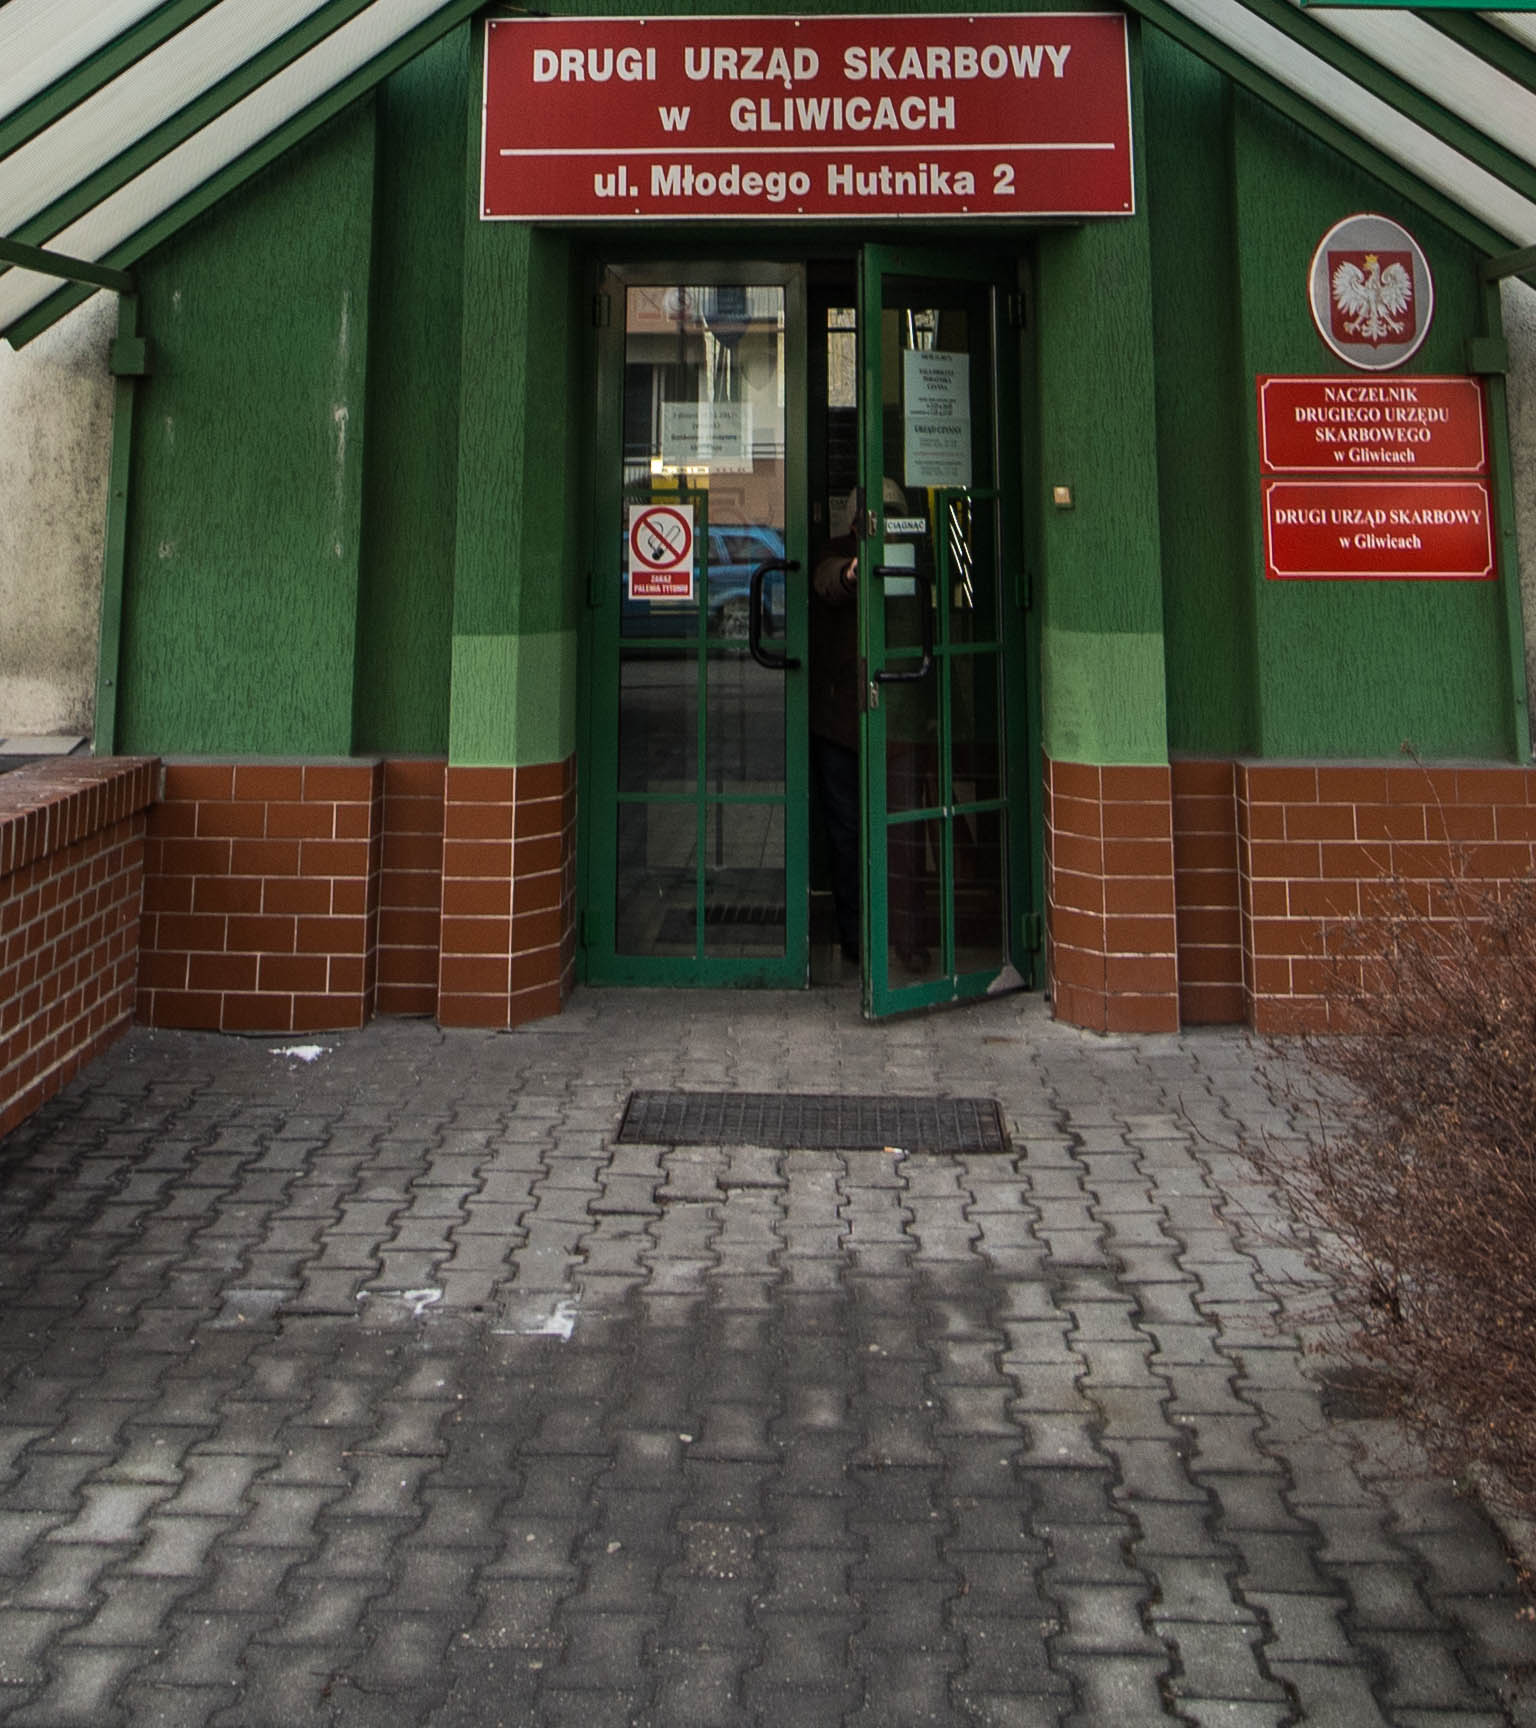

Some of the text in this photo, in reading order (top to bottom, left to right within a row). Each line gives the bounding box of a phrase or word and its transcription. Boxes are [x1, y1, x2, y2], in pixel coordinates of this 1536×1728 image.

[532, 45, 1071, 90] DRUGI URZĄD SKARBOWY
[658, 96, 956, 132] w GLIWICACH
[594, 164, 1016, 202] ul. Młodego Hutnika 2
[1324, 387, 1418, 403] NACZELNIK
[1294, 407, 1449, 426] DRUGIEGO URZĘDU
[1315, 427, 1432, 443] SKARBOWEGO
[1333, 447, 1415, 463] w Gliwicach
[1275, 508, 1482, 528] DRUGI URZĄD SKARBOWY
[1339, 533, 1422, 549] w Gliwicach
